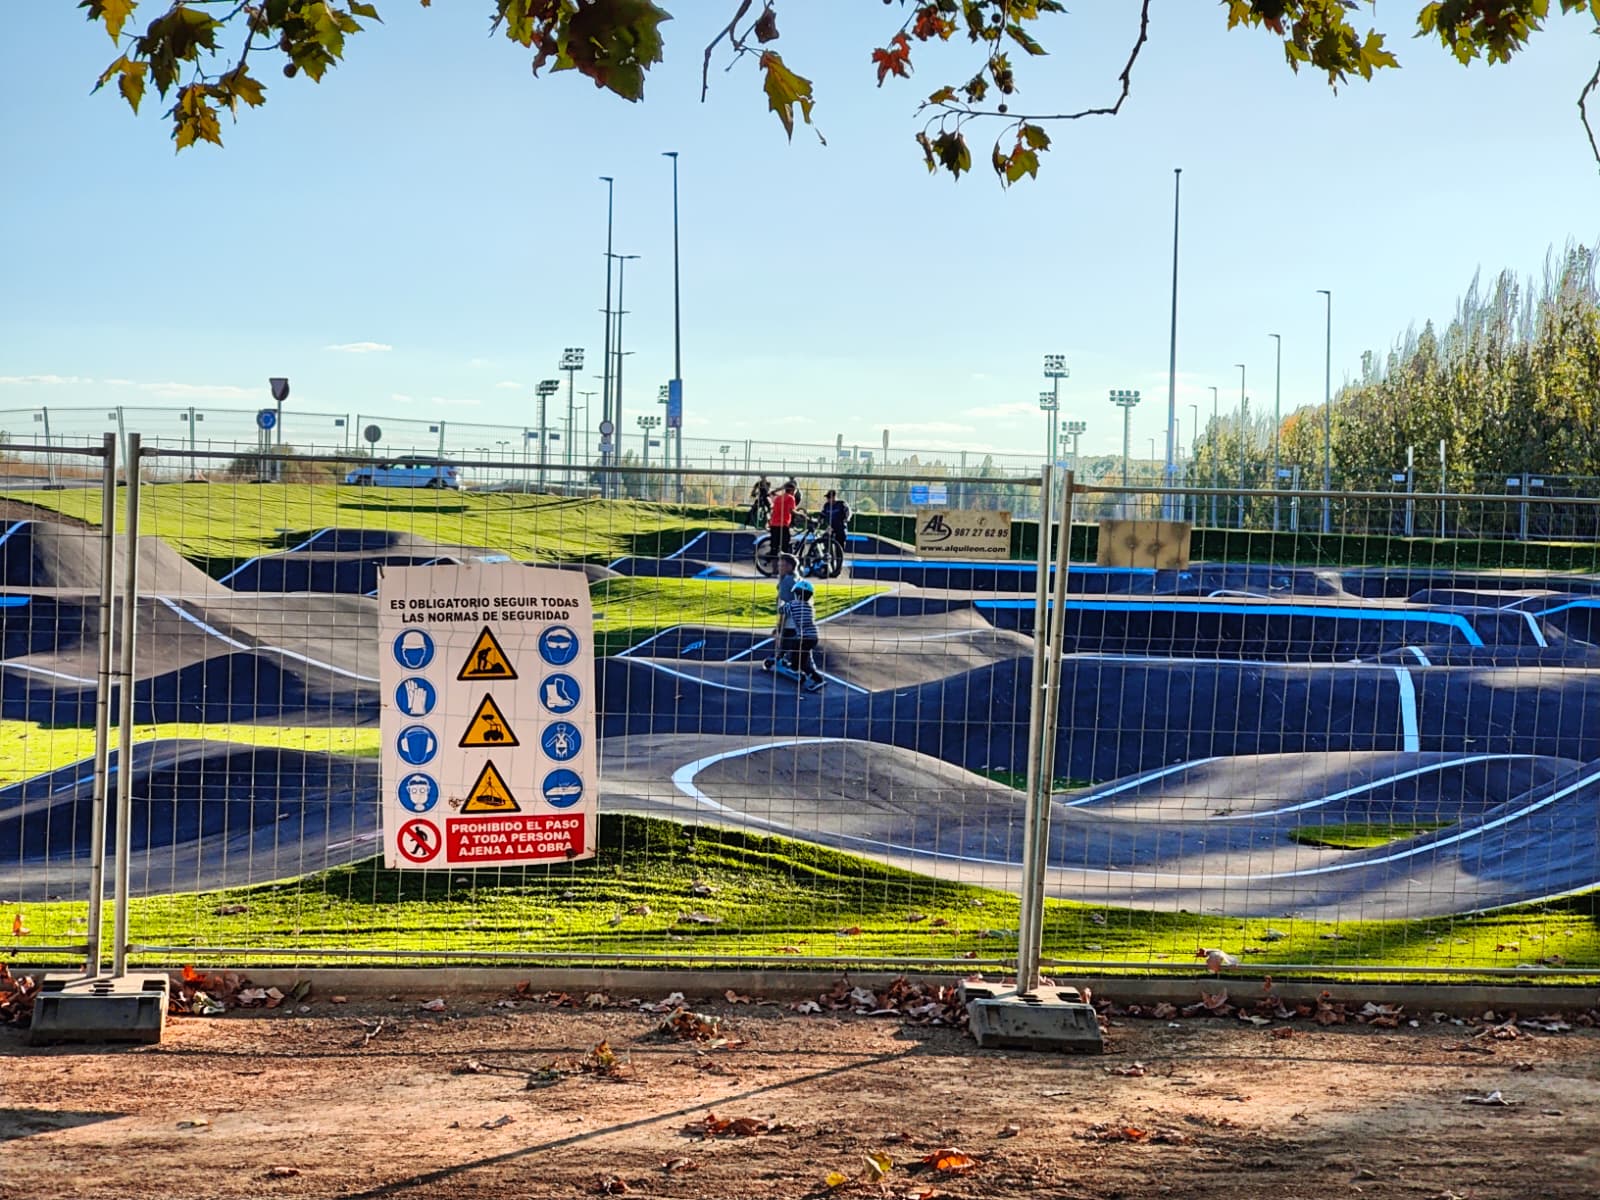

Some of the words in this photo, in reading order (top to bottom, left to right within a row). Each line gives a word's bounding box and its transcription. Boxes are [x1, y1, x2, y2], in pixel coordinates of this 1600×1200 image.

[923, 515, 947, 533] AL
[954, 528, 970, 537] 987
[971, 528, 984, 537] 27
[984, 528, 995, 537] 62
[997, 528, 1009, 538] 95
[920, 545, 1006, 553] www.alquileon.com
[390, 600, 406, 610] ES
[409, 598, 490, 609] OBLIGATORIO
[493, 597, 538, 608] SEGUIR
[540, 597, 579, 608] TODAS
[402, 613, 425, 623] LAS
[428, 612, 479, 623] NORMAS
[482, 611, 498, 622] DE
[501, 610, 570, 621] SEGURIDAD
[451, 822, 523, 833] PROHIBIDO
[526, 821, 543, 831] EL
[545, 819, 579, 830] PASO
[460, 835, 470, 845] A
[472, 833, 508, 844] TODA
[511, 831, 571, 843] PERSONA
[459, 845, 501, 857] AJENA
[504, 844, 514, 854] A
[517, 843, 534, 853] LA
[537, 842, 573, 853] OBRA
